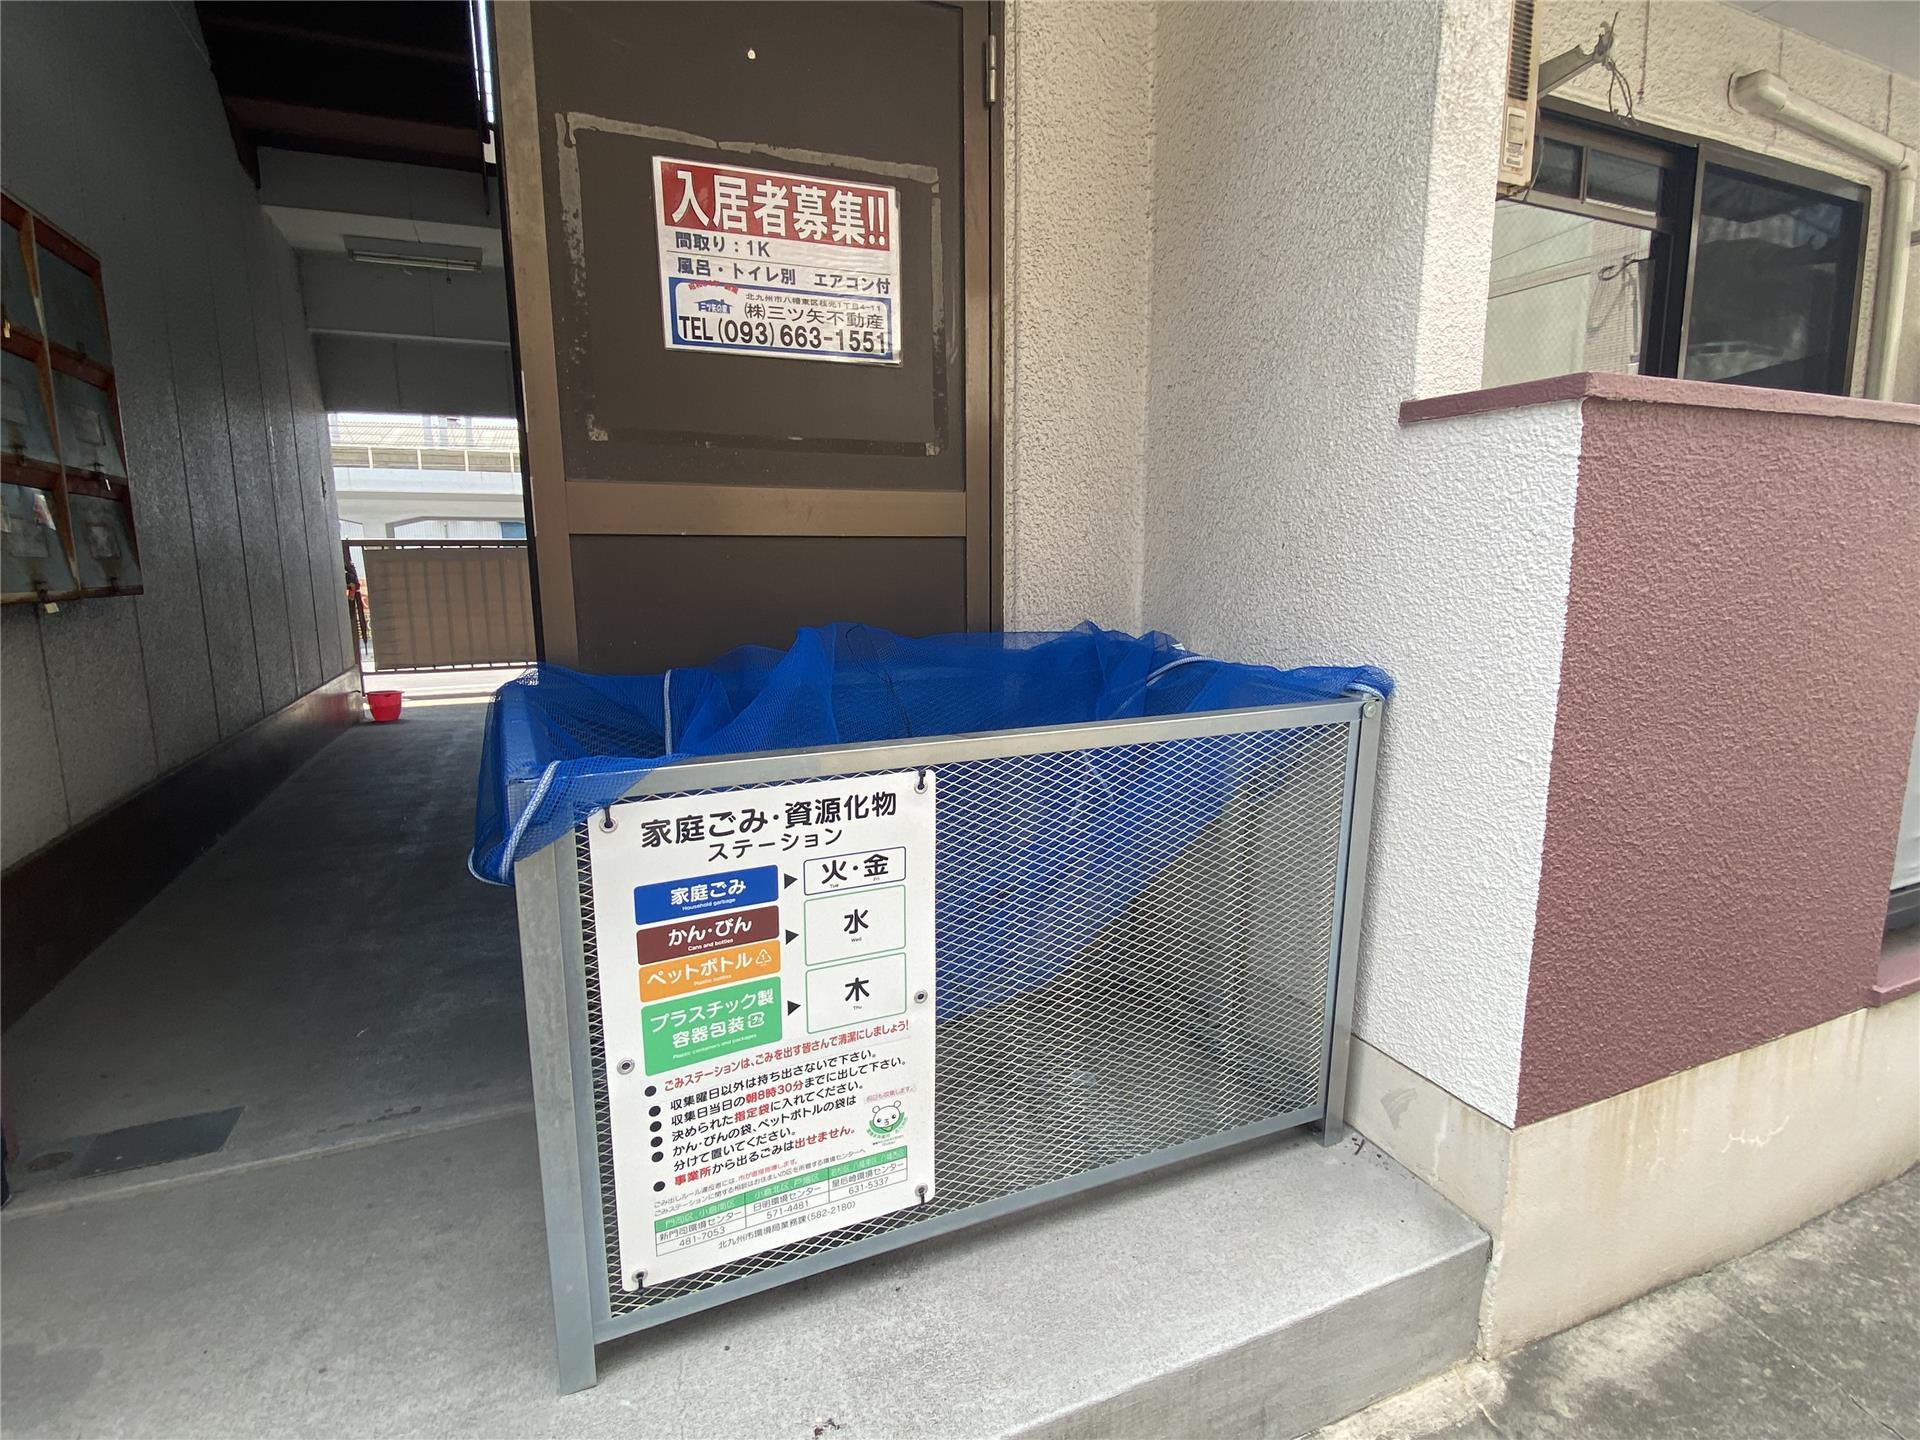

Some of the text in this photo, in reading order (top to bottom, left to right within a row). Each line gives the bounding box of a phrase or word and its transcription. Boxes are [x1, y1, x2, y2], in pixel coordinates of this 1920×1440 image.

[671, 170, 885, 246] 入居者募集!!
[814, 273, 891, 294] エアコン付
[641, 791, 897, 849] 家庭ごみ・資源化物
[708, 827, 843, 863] ステーション
[822, 853, 889, 884] 火・金
[671, 879, 746, 905] 家庭ごみ
[668, 917, 752, 947] かん・びん
[843, 909, 869, 934] 水
[688, 944, 703, 952] Cans
[703, 941, 714, 949] and
[647, 952, 752, 985] ペットボトル
[845, 977, 870, 1001] 木
[650, 988, 774, 1033] プラスチック製
[672, 1016, 745, 1048] 容器包装
[849, 1177, 889, 1194] 631-5337
[766, 1200, 809, 1219] 571-4481
[679, 1226, 726, 1247] 481-7053
